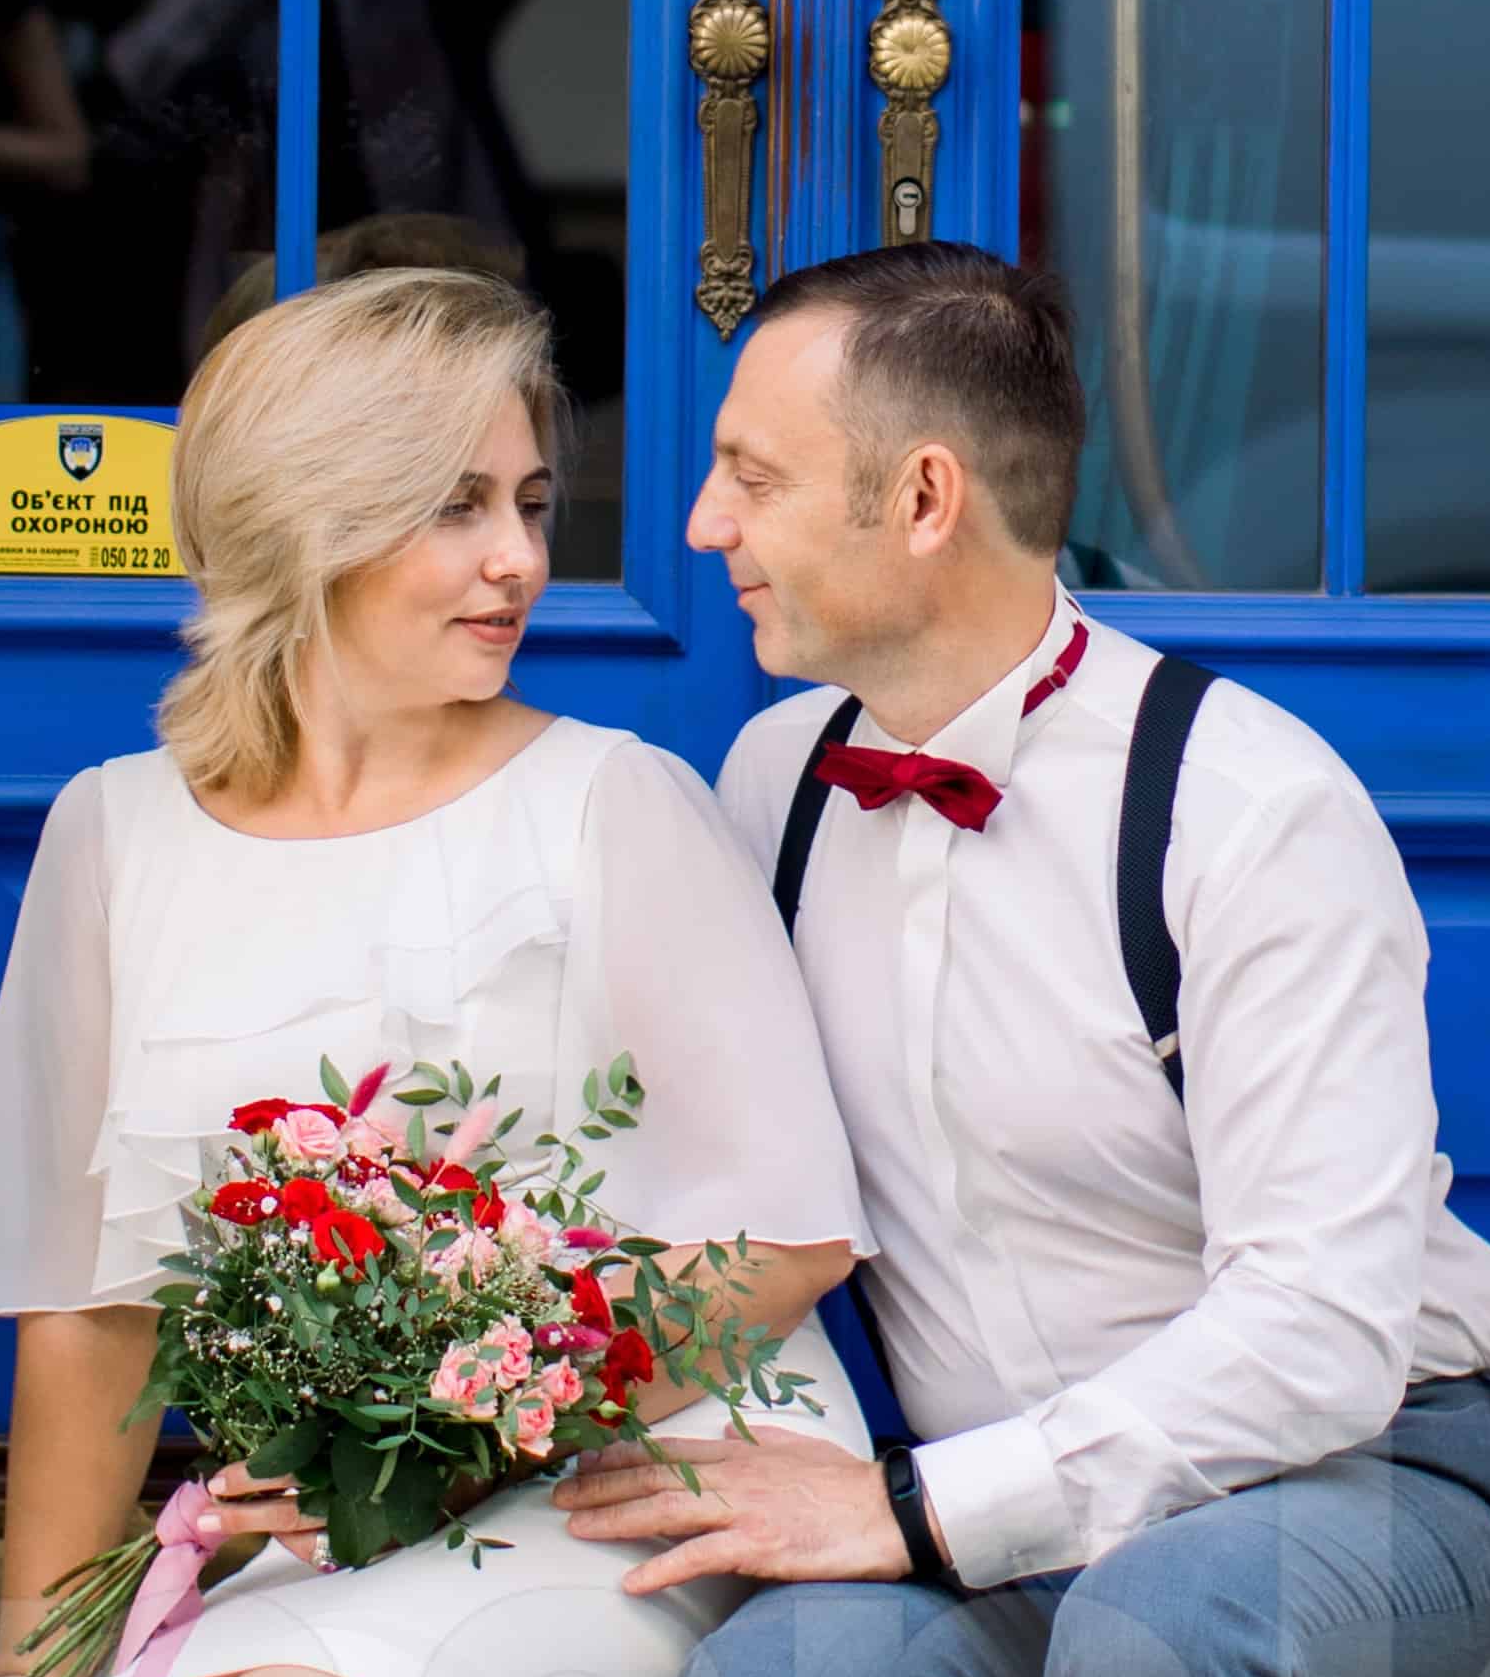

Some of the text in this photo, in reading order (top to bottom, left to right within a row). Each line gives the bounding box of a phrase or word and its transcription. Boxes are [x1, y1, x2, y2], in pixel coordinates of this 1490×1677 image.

[100, 547, 127, 568] 050
[131, 548, 149, 568] 22
[153, 548, 170, 568] 20
